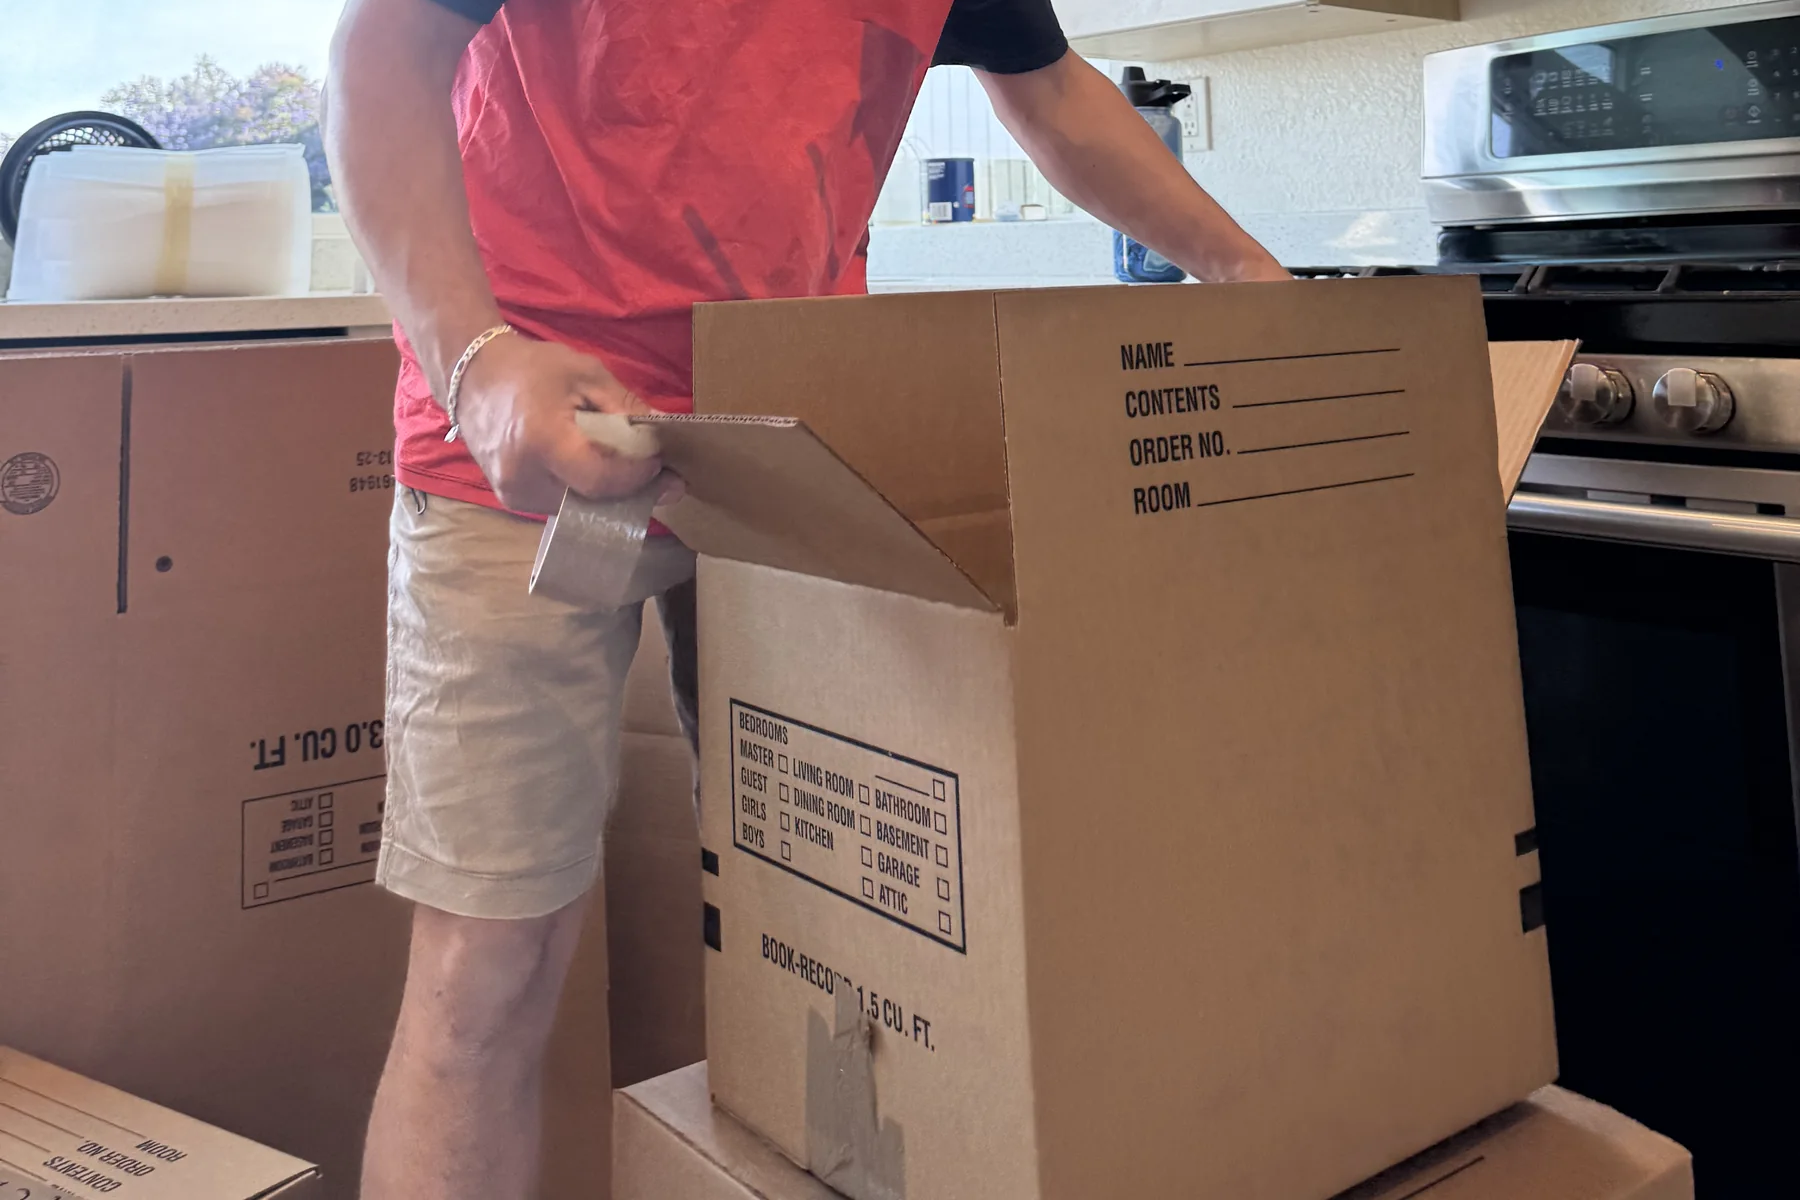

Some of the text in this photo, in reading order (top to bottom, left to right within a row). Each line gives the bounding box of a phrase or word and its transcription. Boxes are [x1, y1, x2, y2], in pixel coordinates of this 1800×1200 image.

[1121, 342, 1174, 371] NAME
[1125, 385, 1220, 418] CONTENTS
[1129, 431, 1232, 467] ORDER NO.
[1134, 482, 1191, 515] ROOM
[250, 719, 384, 771] 3.0 CU. FT.
[739, 712, 788, 745] BEDROOMS
[740, 739, 774, 768] MASTER
[741, 767, 768, 794] GUEST
[793, 758, 854, 799] LIVING ROOM
[742, 795, 767, 821] GIRLS
[794, 787, 856, 830] DINING ROOM
[875, 789, 931, 828] BATHROOM
[742, 822, 765, 849] BOYS
[795, 817, 834, 851] KITCHEN
[877, 820, 930, 859] BASEMENT
[878, 852, 920, 888] GARAGE
[879, 883, 908, 915] ATTIC
[762, 933, 935, 1052] BOOK-RECO 1.5 CU. FT.
[77, 1140, 155, 1177] ORDER NO.
[135, 1140, 187, 1162] ROOM
[43, 1156, 122, 1192] CONTENTS
